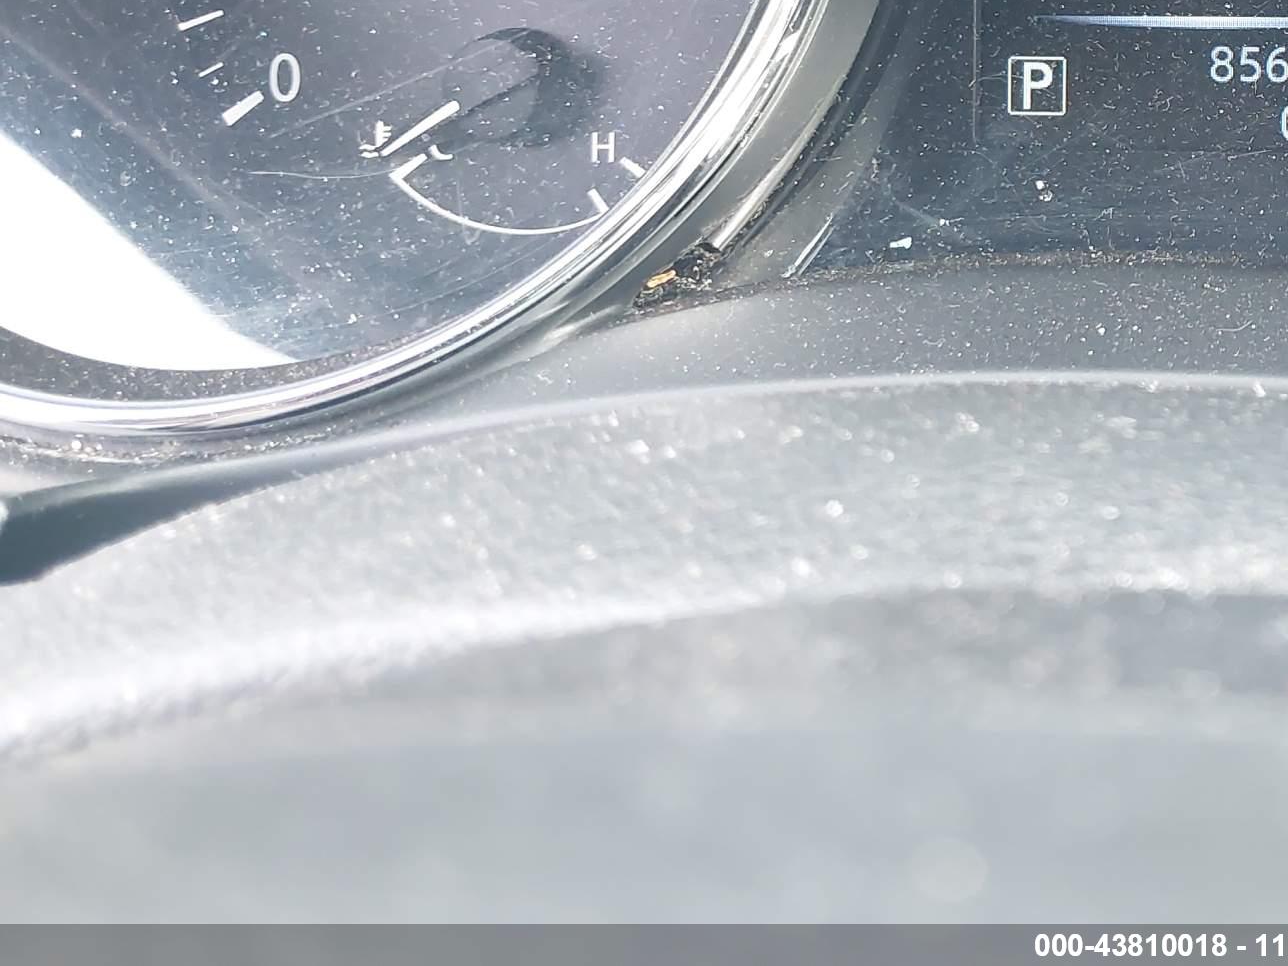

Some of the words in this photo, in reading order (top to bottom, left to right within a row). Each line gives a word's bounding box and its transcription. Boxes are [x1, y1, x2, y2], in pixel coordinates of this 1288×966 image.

[270, 53, 300, 102] 0
[1020, 62, 1053, 109] P
[591, 132, 615, 163] H
